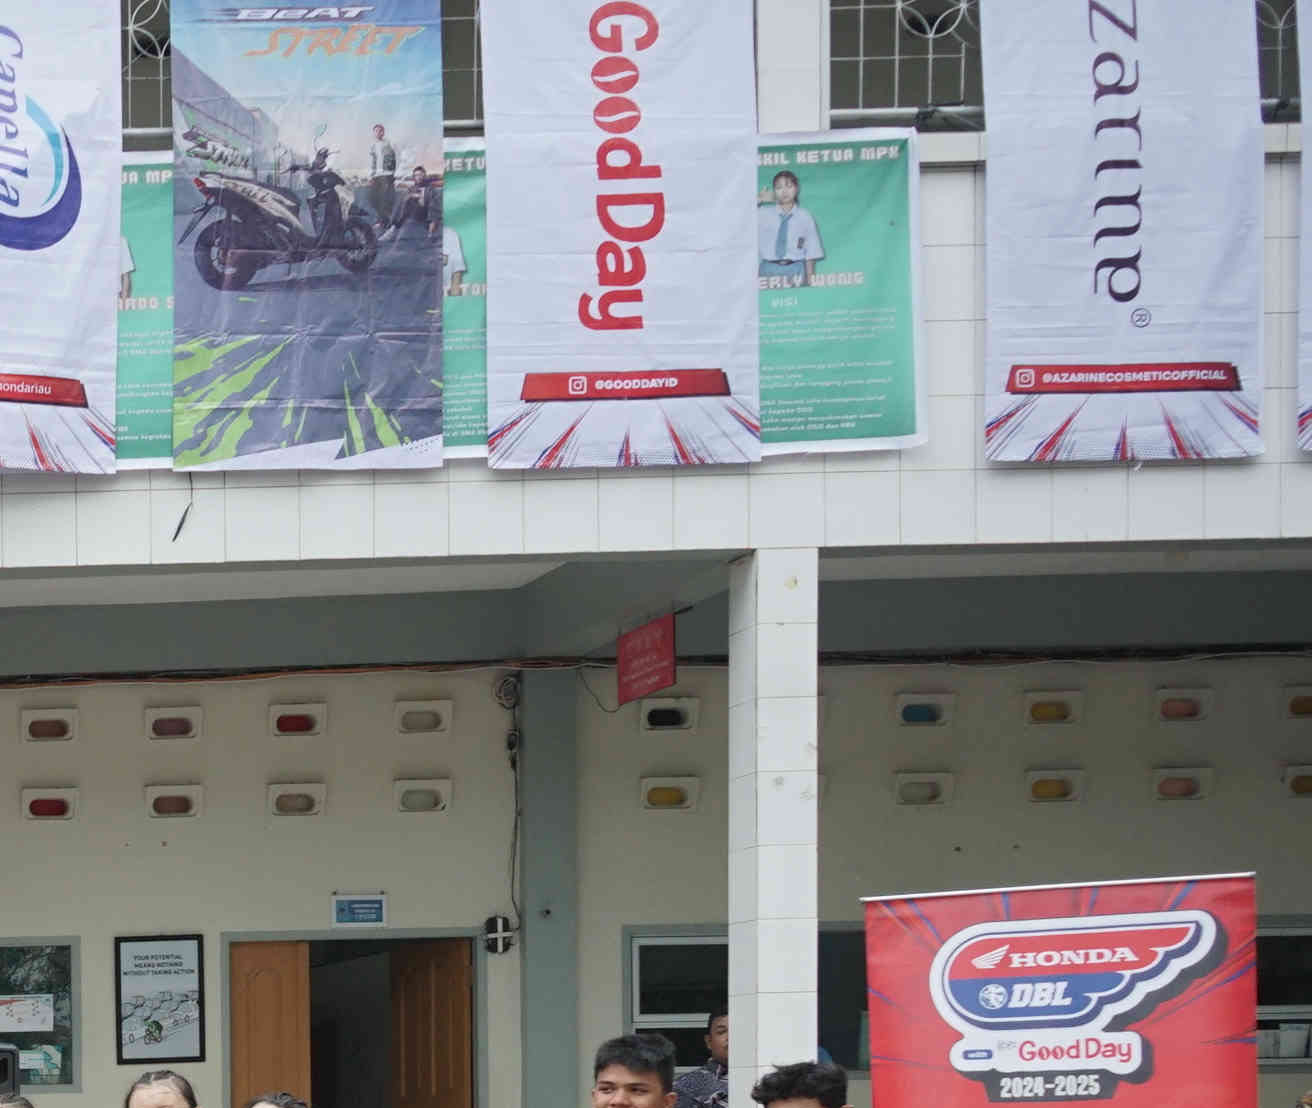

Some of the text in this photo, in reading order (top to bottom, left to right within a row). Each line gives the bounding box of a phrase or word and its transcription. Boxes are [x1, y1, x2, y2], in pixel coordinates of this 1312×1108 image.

[243, 24, 426, 57] STREET
[578, 0, 665, 331] Good Day
[594, 376, 679, 391] @GOODDAYID
[1041, 366, 1229, 387] @AZARINECOSMETICOFFICIAL
[1009, 947, 1140, 968] HONDA
[1008, 981, 1074, 1009] DBL
[1018, 1039, 1080, 1061] Good
[1084, 1037, 1133, 1063] Day
[999, 1074, 1102, 1098] 2024-2025
